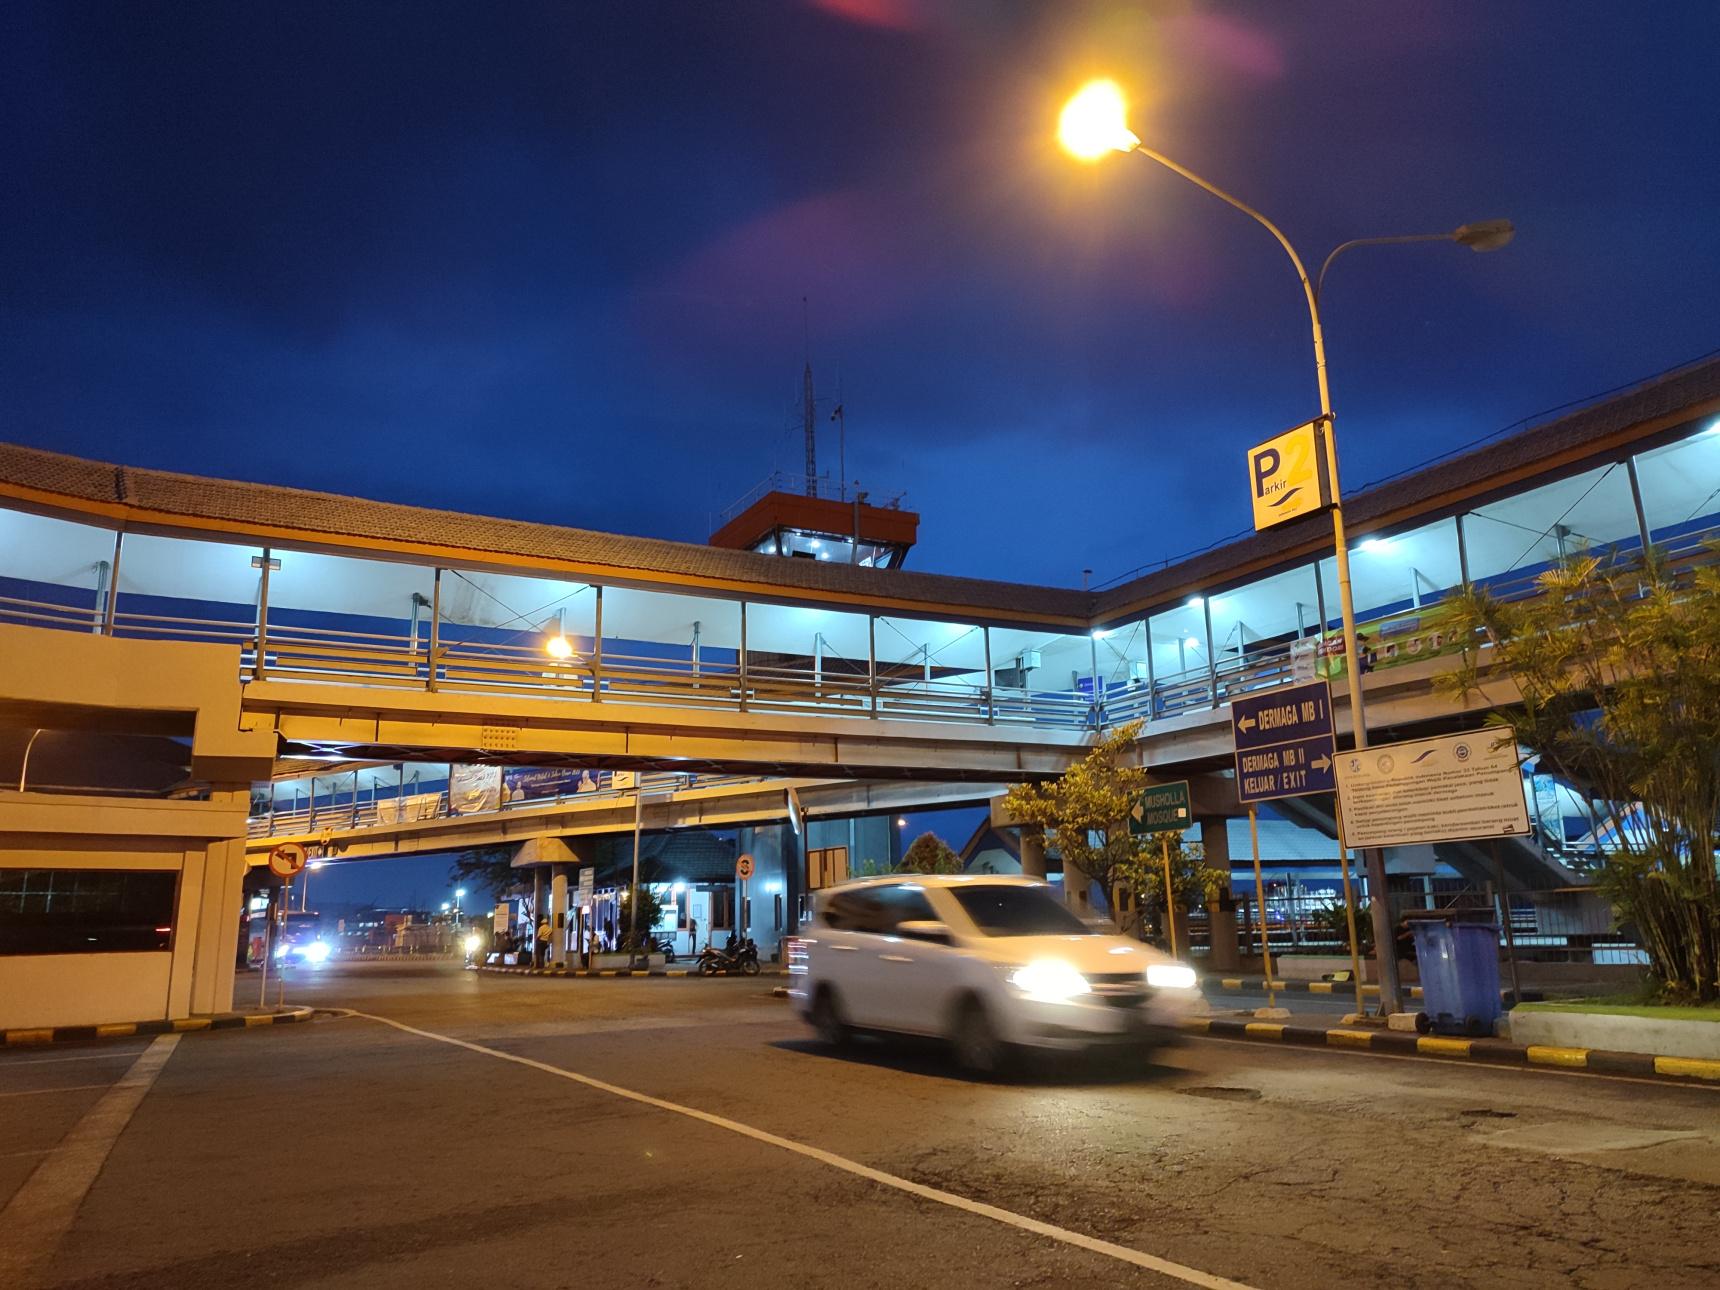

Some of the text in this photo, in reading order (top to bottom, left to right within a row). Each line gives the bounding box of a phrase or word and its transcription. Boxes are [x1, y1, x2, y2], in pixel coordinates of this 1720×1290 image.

[1258, 703, 1299, 732] DERMAGA
[1301, 700, 1316, 724] MB
[1242, 747, 1305, 774] DERMAGA MB II
[1243, 774, 1276, 795] KELUAR
[1282, 769, 1307, 790] EXIT
[1144, 790, 1185, 808] MUSHOLLA
[1146, 807, 1178, 825] MOSQUE
